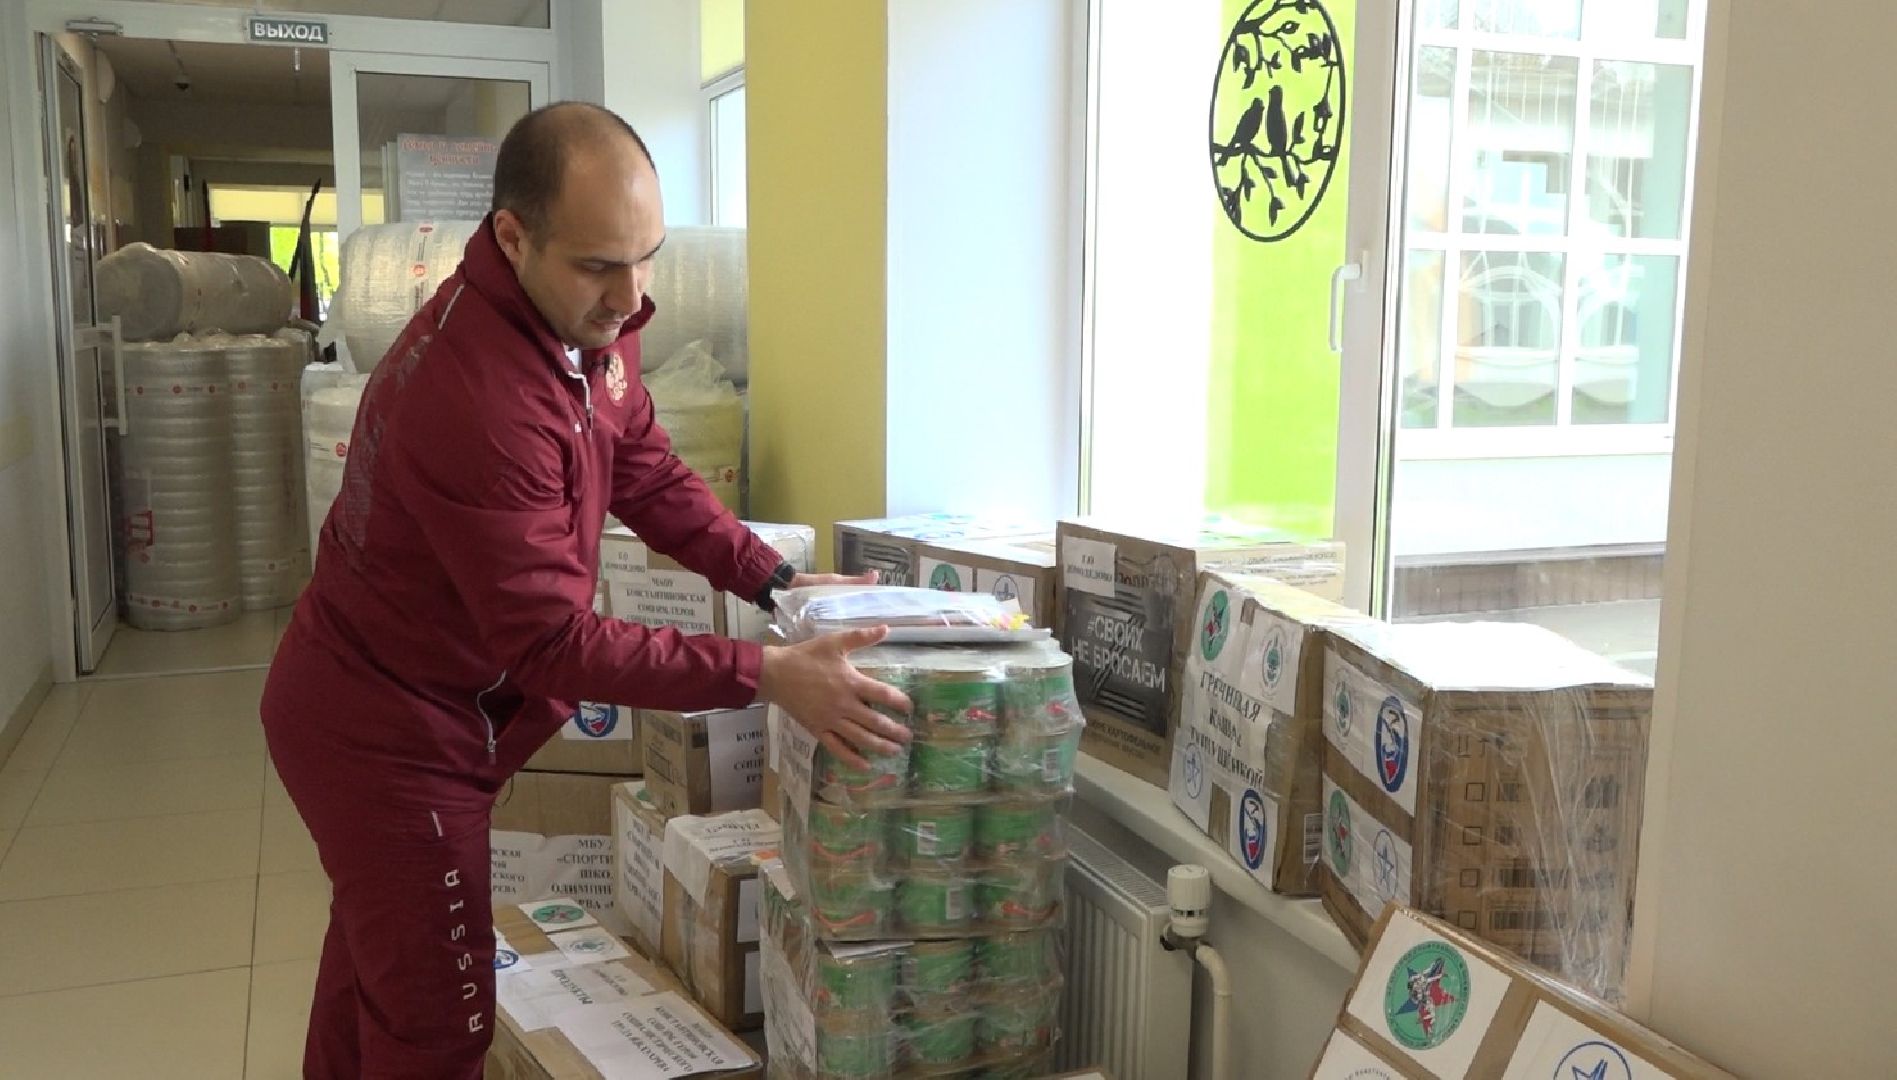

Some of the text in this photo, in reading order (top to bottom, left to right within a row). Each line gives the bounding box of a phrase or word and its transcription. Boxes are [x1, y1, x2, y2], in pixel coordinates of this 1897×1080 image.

[254, 23, 324, 42] ВЫХОД
[1087, 615, 1144, 652] #СВОИХ
[1072, 636, 1165, 693] НЕ БРОСАЕМ
[444, 868, 485, 1033] RUSSIA
